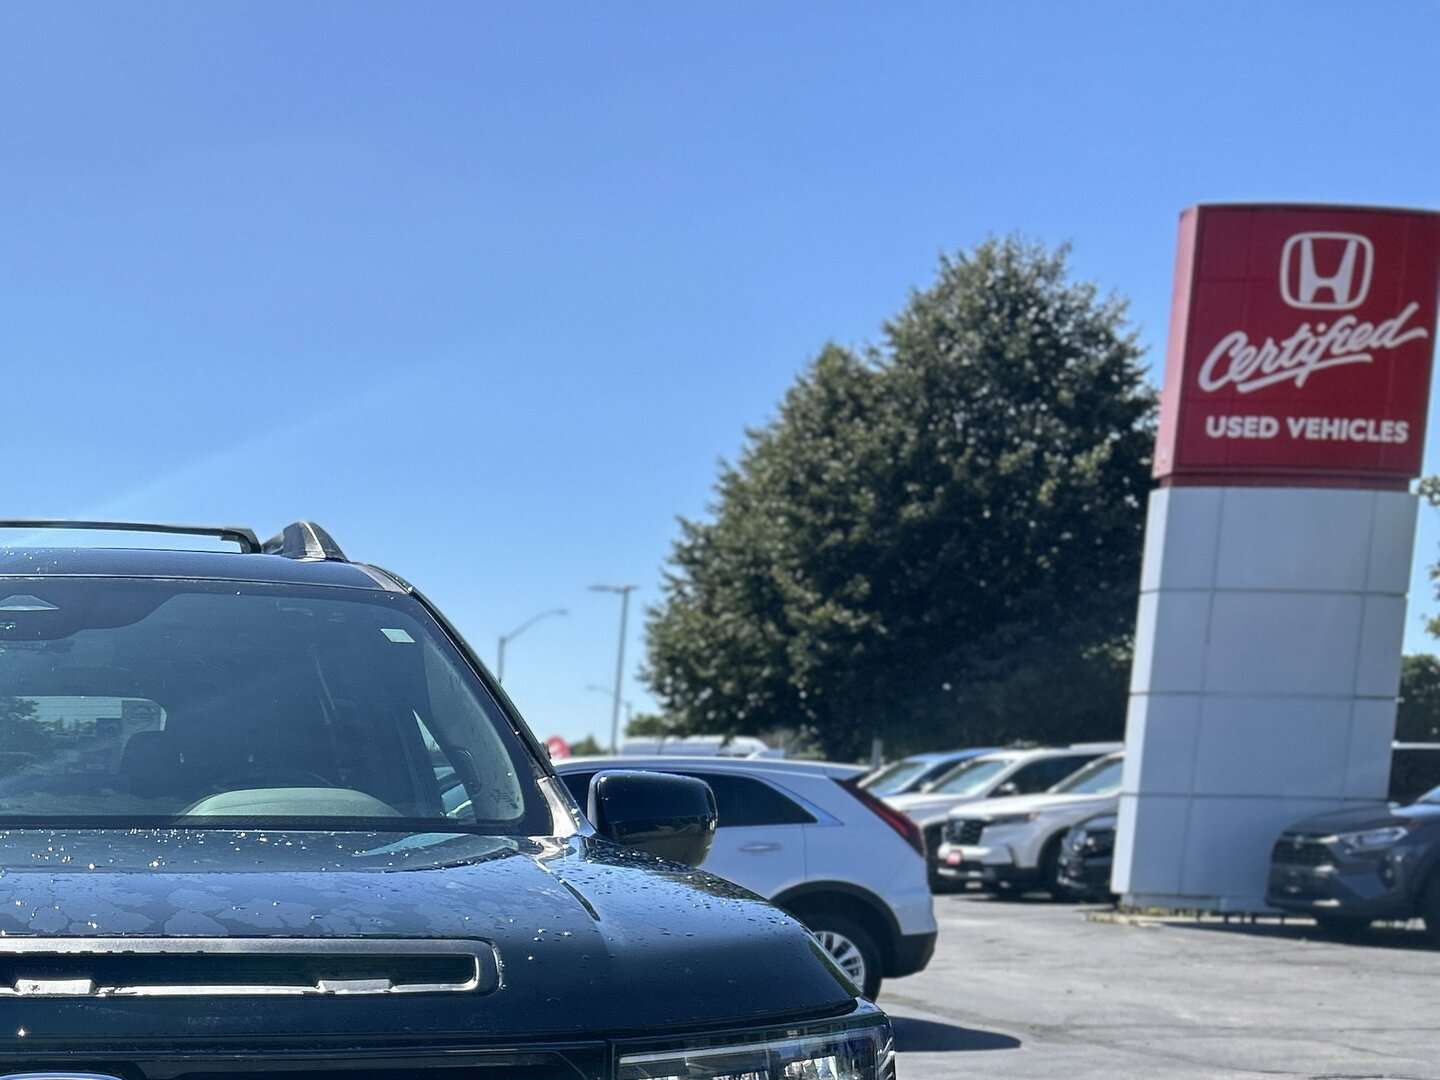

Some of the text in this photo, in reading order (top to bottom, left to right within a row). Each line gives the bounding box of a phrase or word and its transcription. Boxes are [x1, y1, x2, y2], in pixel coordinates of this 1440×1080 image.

[1198, 302, 1428, 393] Certified
[1206, 416, 1409, 443] USED VEHICLES
